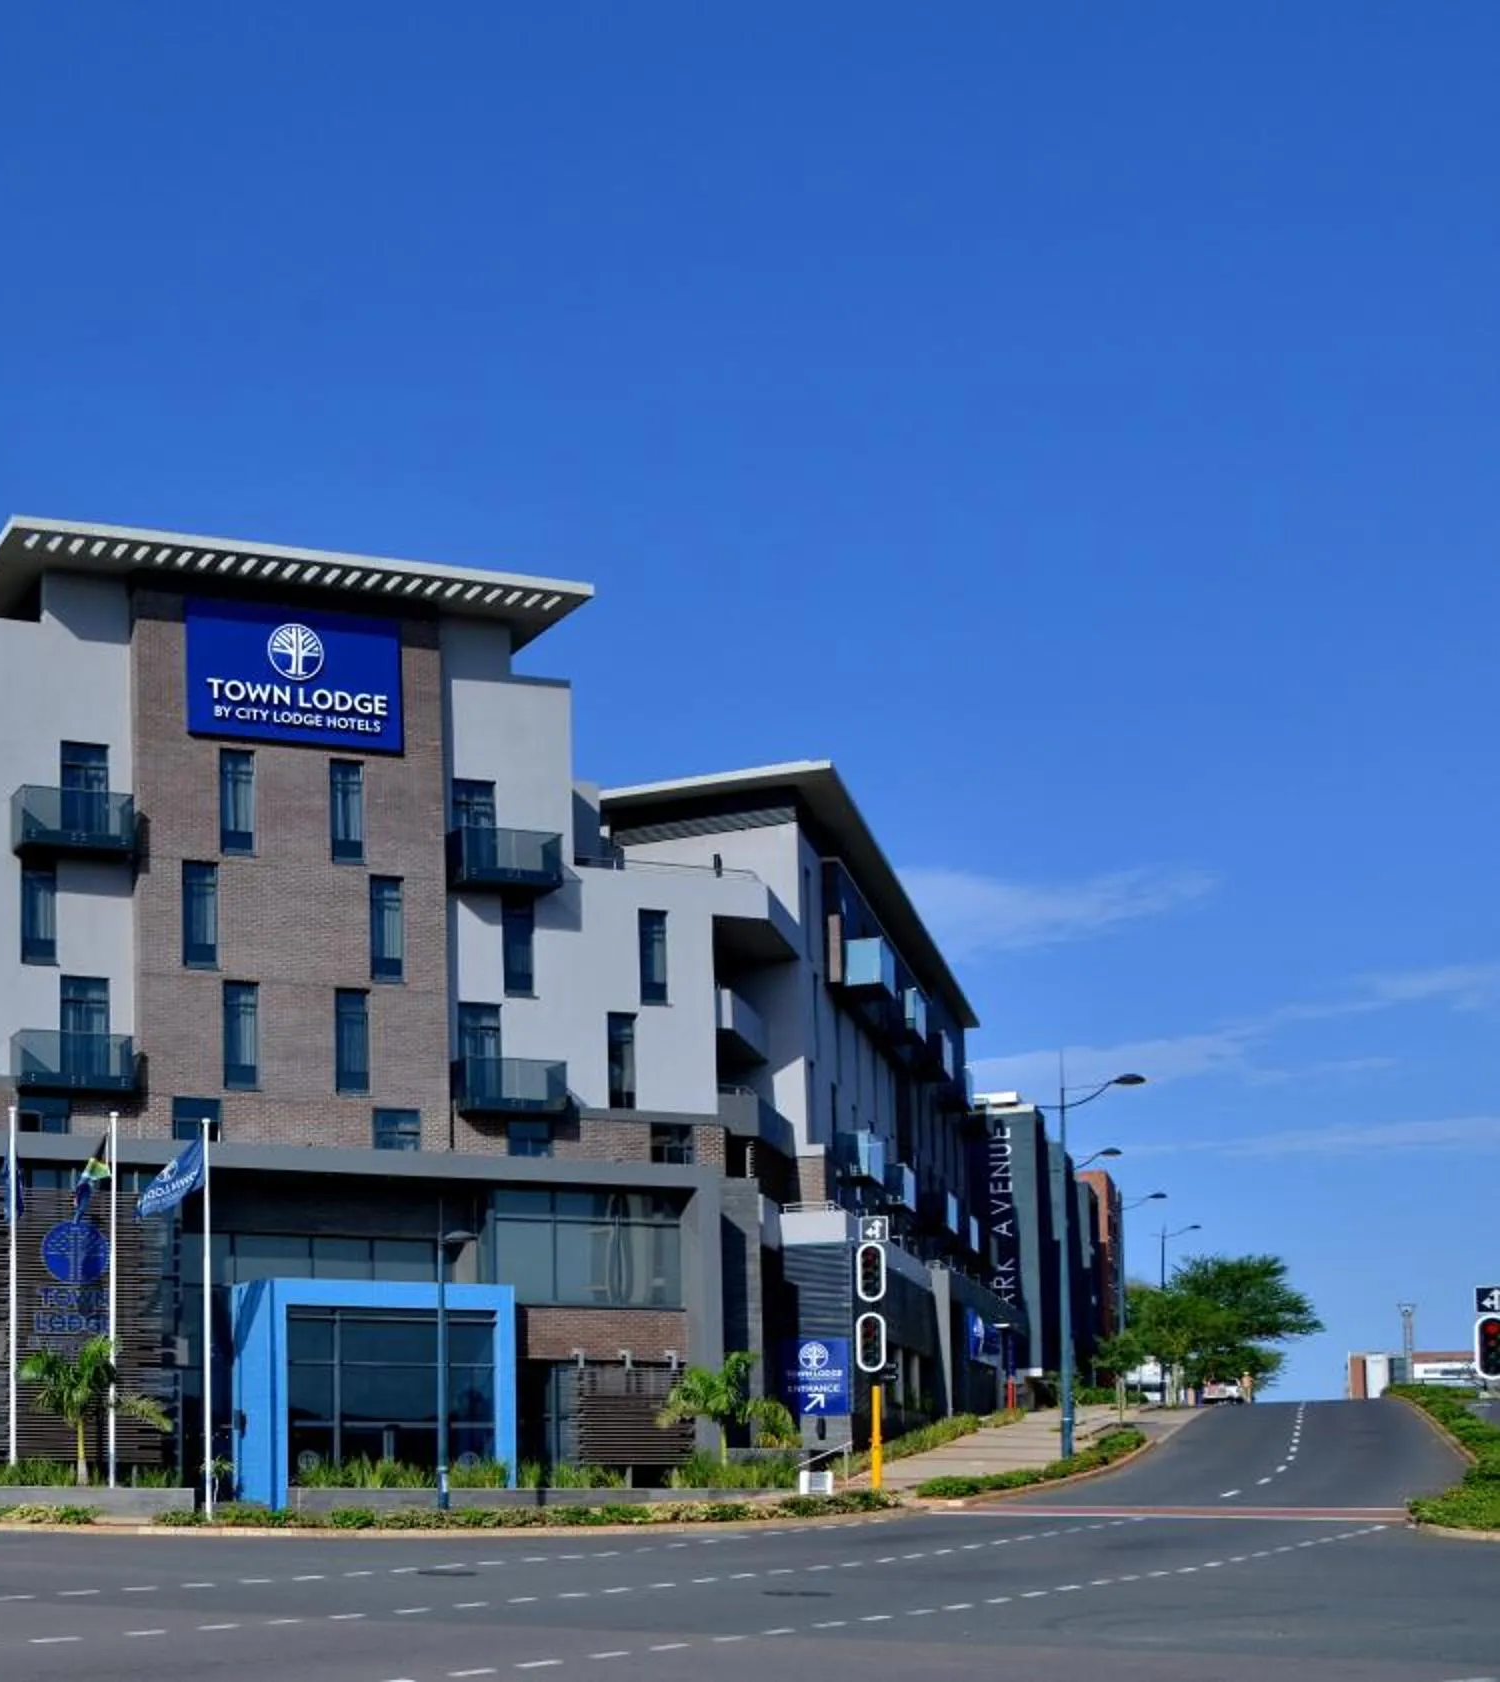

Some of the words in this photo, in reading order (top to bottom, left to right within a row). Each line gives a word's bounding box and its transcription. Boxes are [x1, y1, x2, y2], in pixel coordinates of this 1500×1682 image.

[206, 677, 291, 706] TOWN
[299, 687, 389, 716] LODGE
[214, 704, 231, 717] BY
[235, 706, 269, 721] CITY
[273, 710, 323, 727] LODGE
[326, 715, 382, 733] HOTELS
[988, 1126, 1014, 1238] AVENUE
[787, 1384, 840, 1392] ENTRANCE
